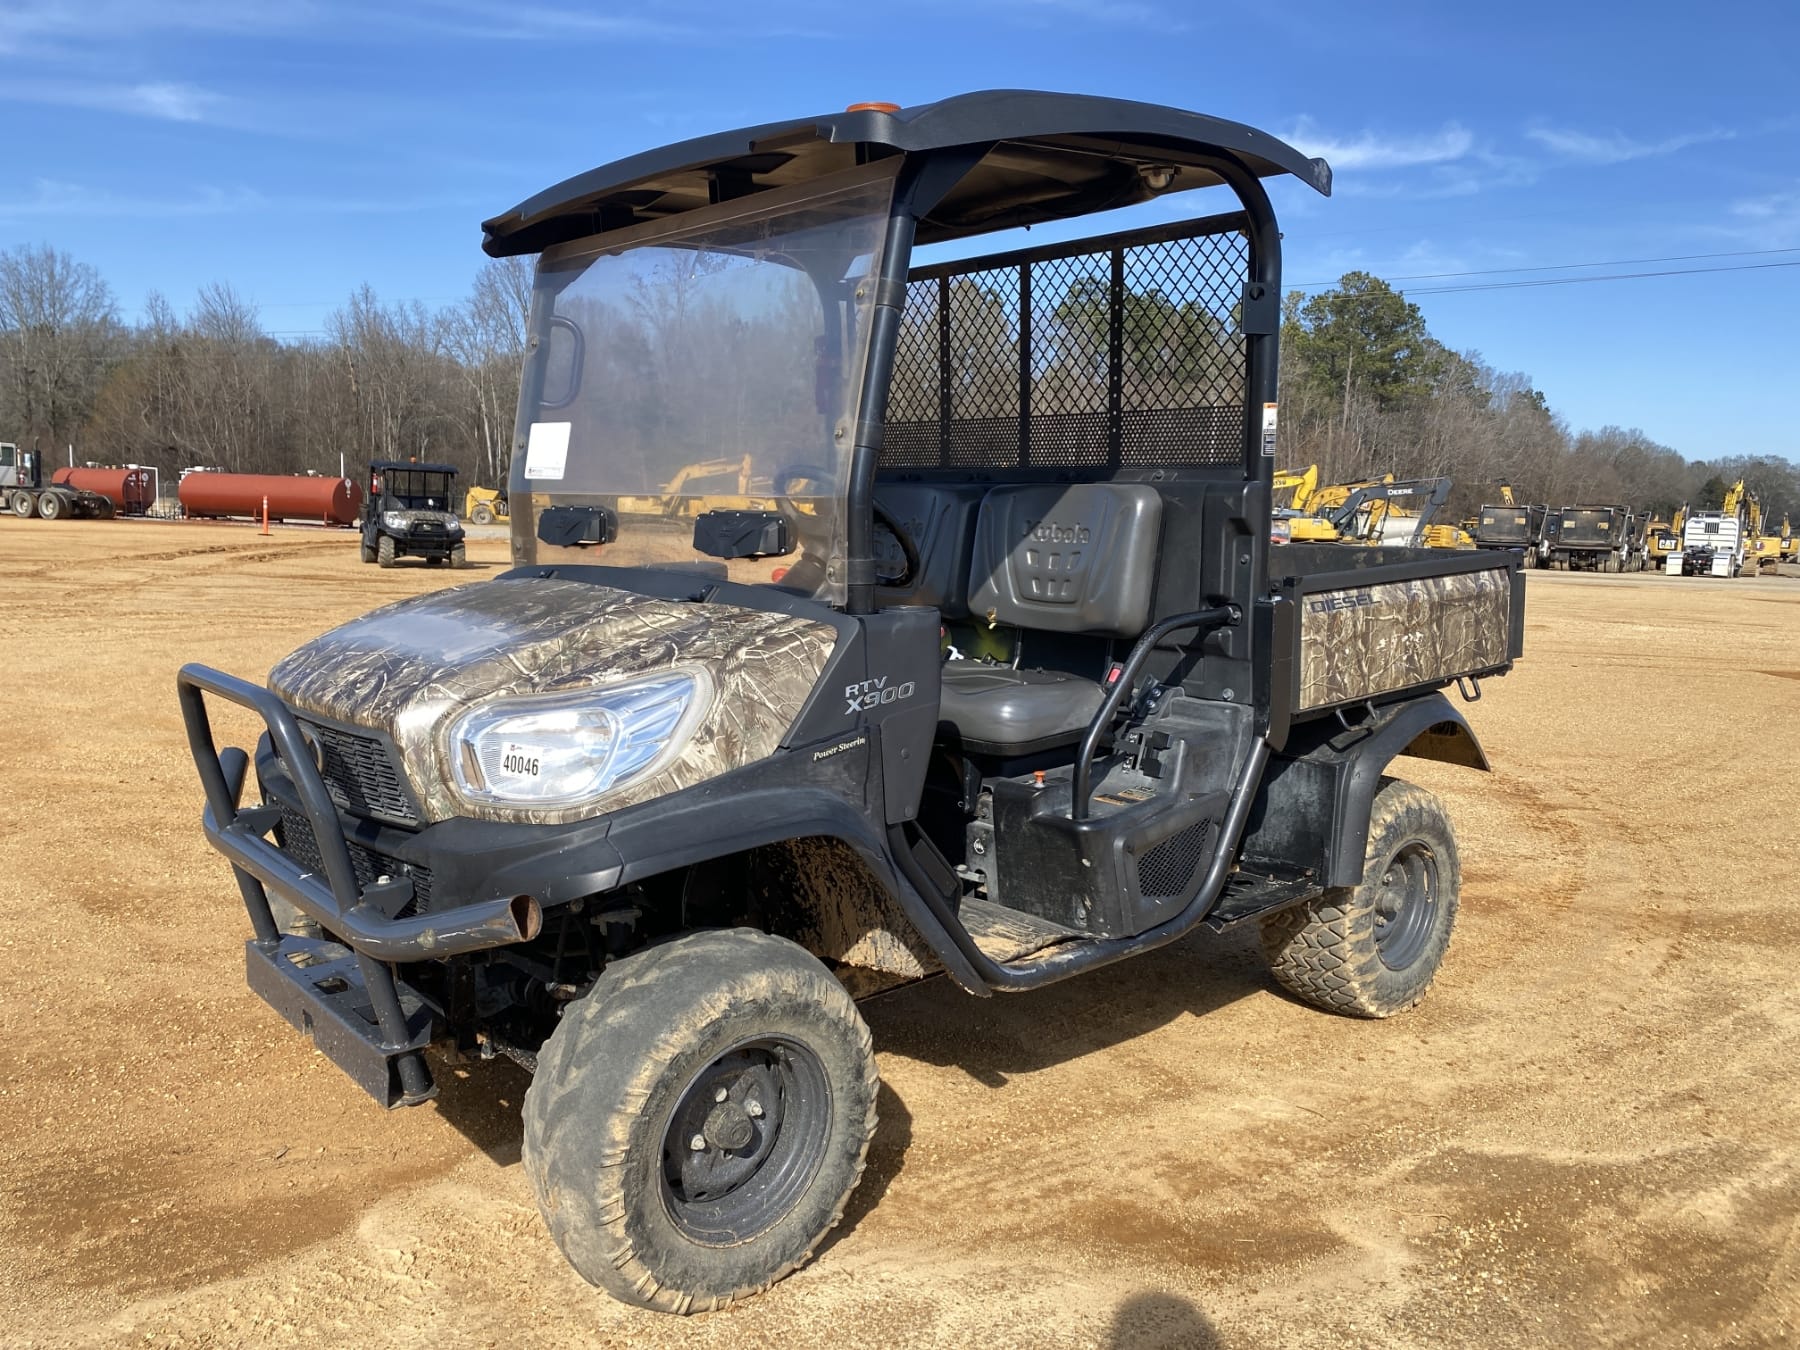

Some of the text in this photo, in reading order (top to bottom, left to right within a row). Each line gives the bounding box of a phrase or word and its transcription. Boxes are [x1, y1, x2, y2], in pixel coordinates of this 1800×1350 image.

[1387, 488, 1413, 496] DEERE
[1658, 539, 1677, 549] CAT
[845, 675, 888, 698] RTV
[844, 681, 916, 715] X900
[813, 746, 838, 762] Power
[503, 754, 539, 776] 40046
